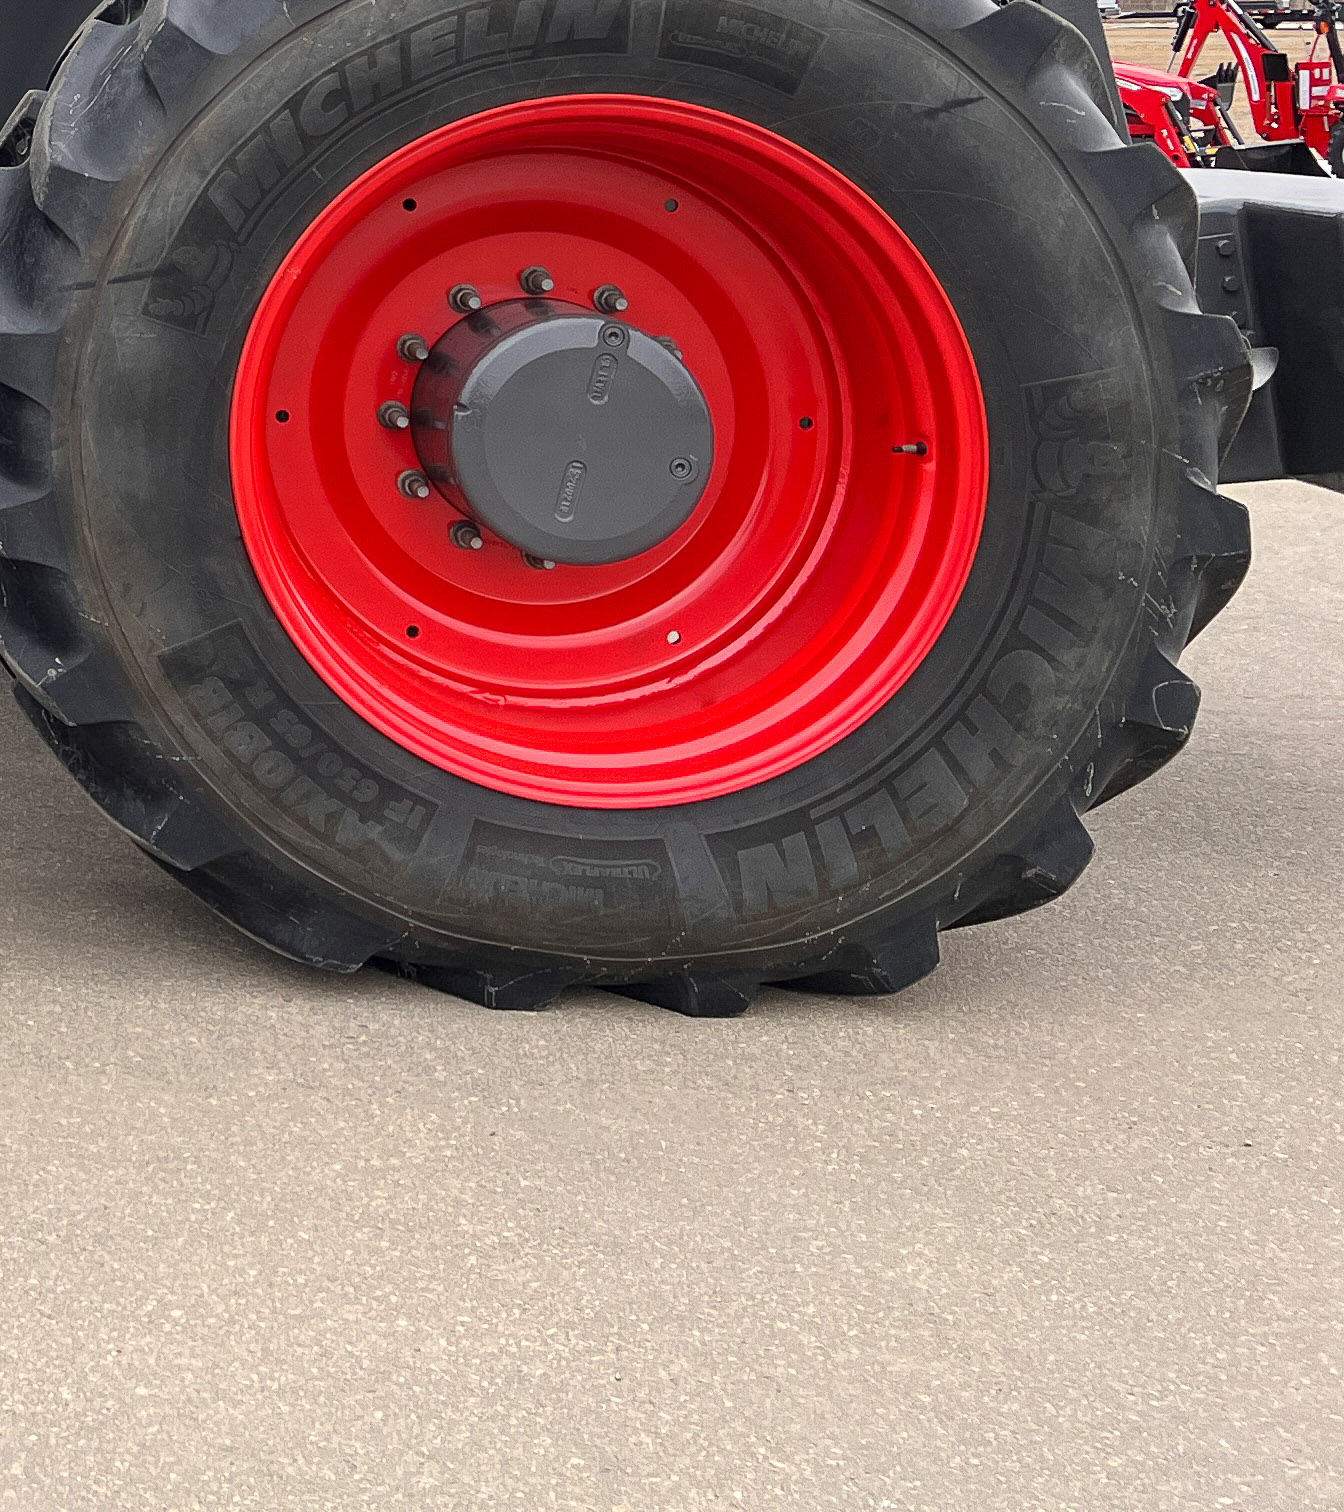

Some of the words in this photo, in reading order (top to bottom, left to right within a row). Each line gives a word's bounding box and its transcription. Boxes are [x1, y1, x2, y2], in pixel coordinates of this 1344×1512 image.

[255, 681, 280, 710] R
[737, 510, 1113, 915] MICHELIN
[271, 707, 381, 803] 650/65
[384, 802, 425, 833] IF
